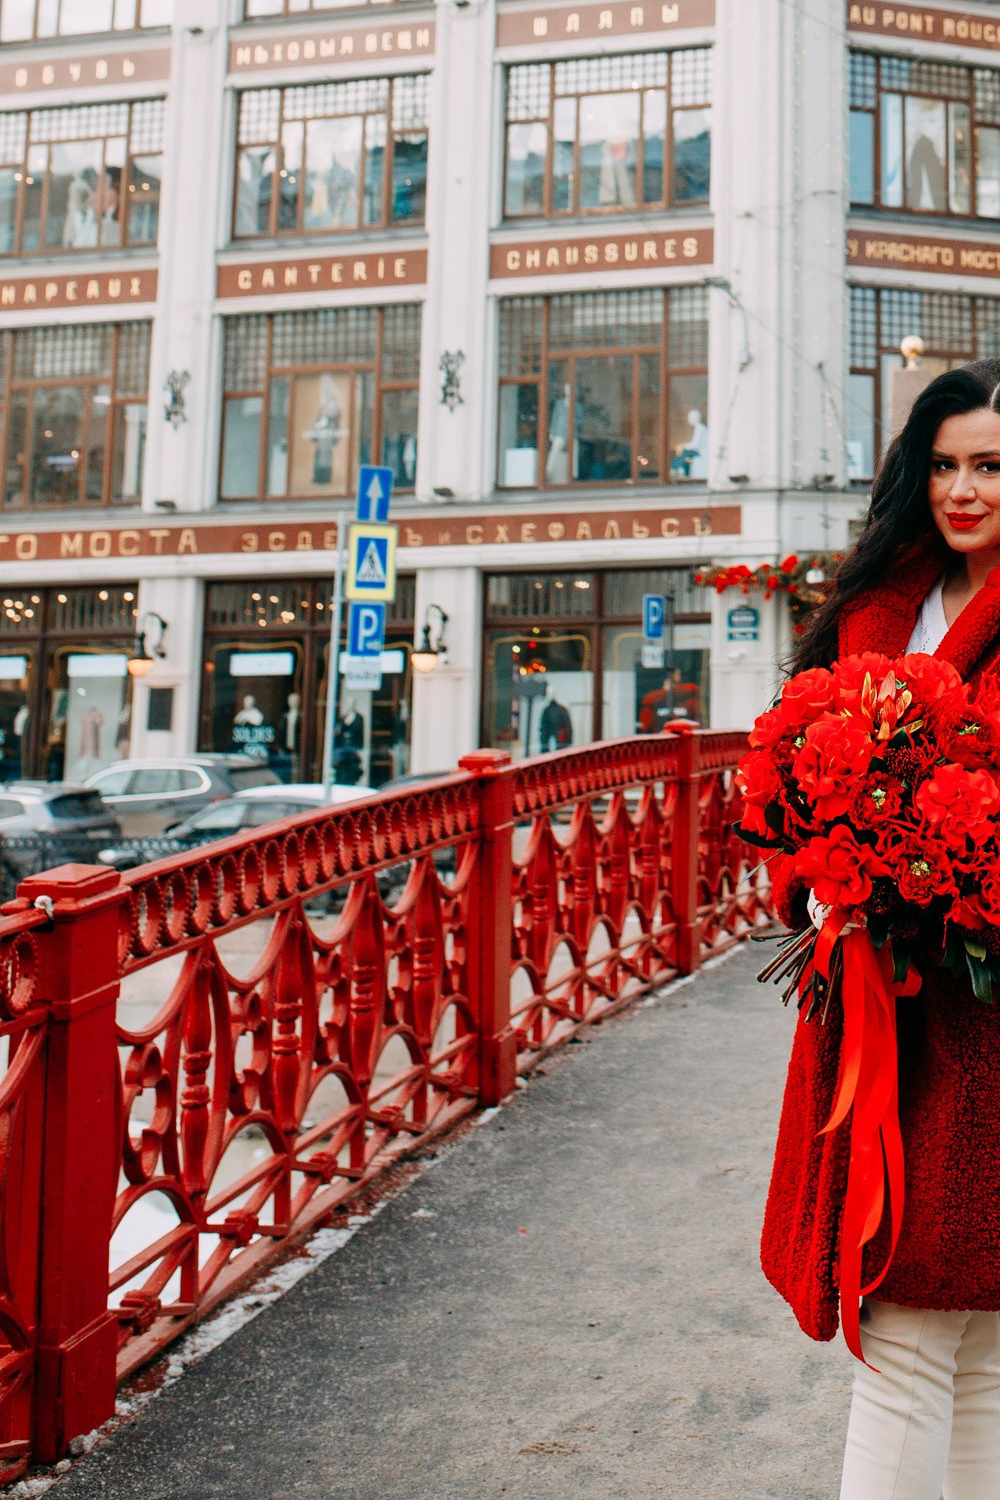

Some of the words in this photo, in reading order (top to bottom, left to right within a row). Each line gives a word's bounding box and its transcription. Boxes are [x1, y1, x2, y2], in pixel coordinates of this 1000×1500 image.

[532, 3, 679, 37] ШЛЯПЫ
[849, 4, 876, 26] AU
[882, 9, 935, 34] PONT
[365, 28, 430, 54] ВЕЩИ
[15, 57, 135, 88] ОБУВЬ
[506, 237, 698, 271] CHAUSSURES
[60, 528, 199, 558] МОСТА
[357, 608, 379, 652] P
